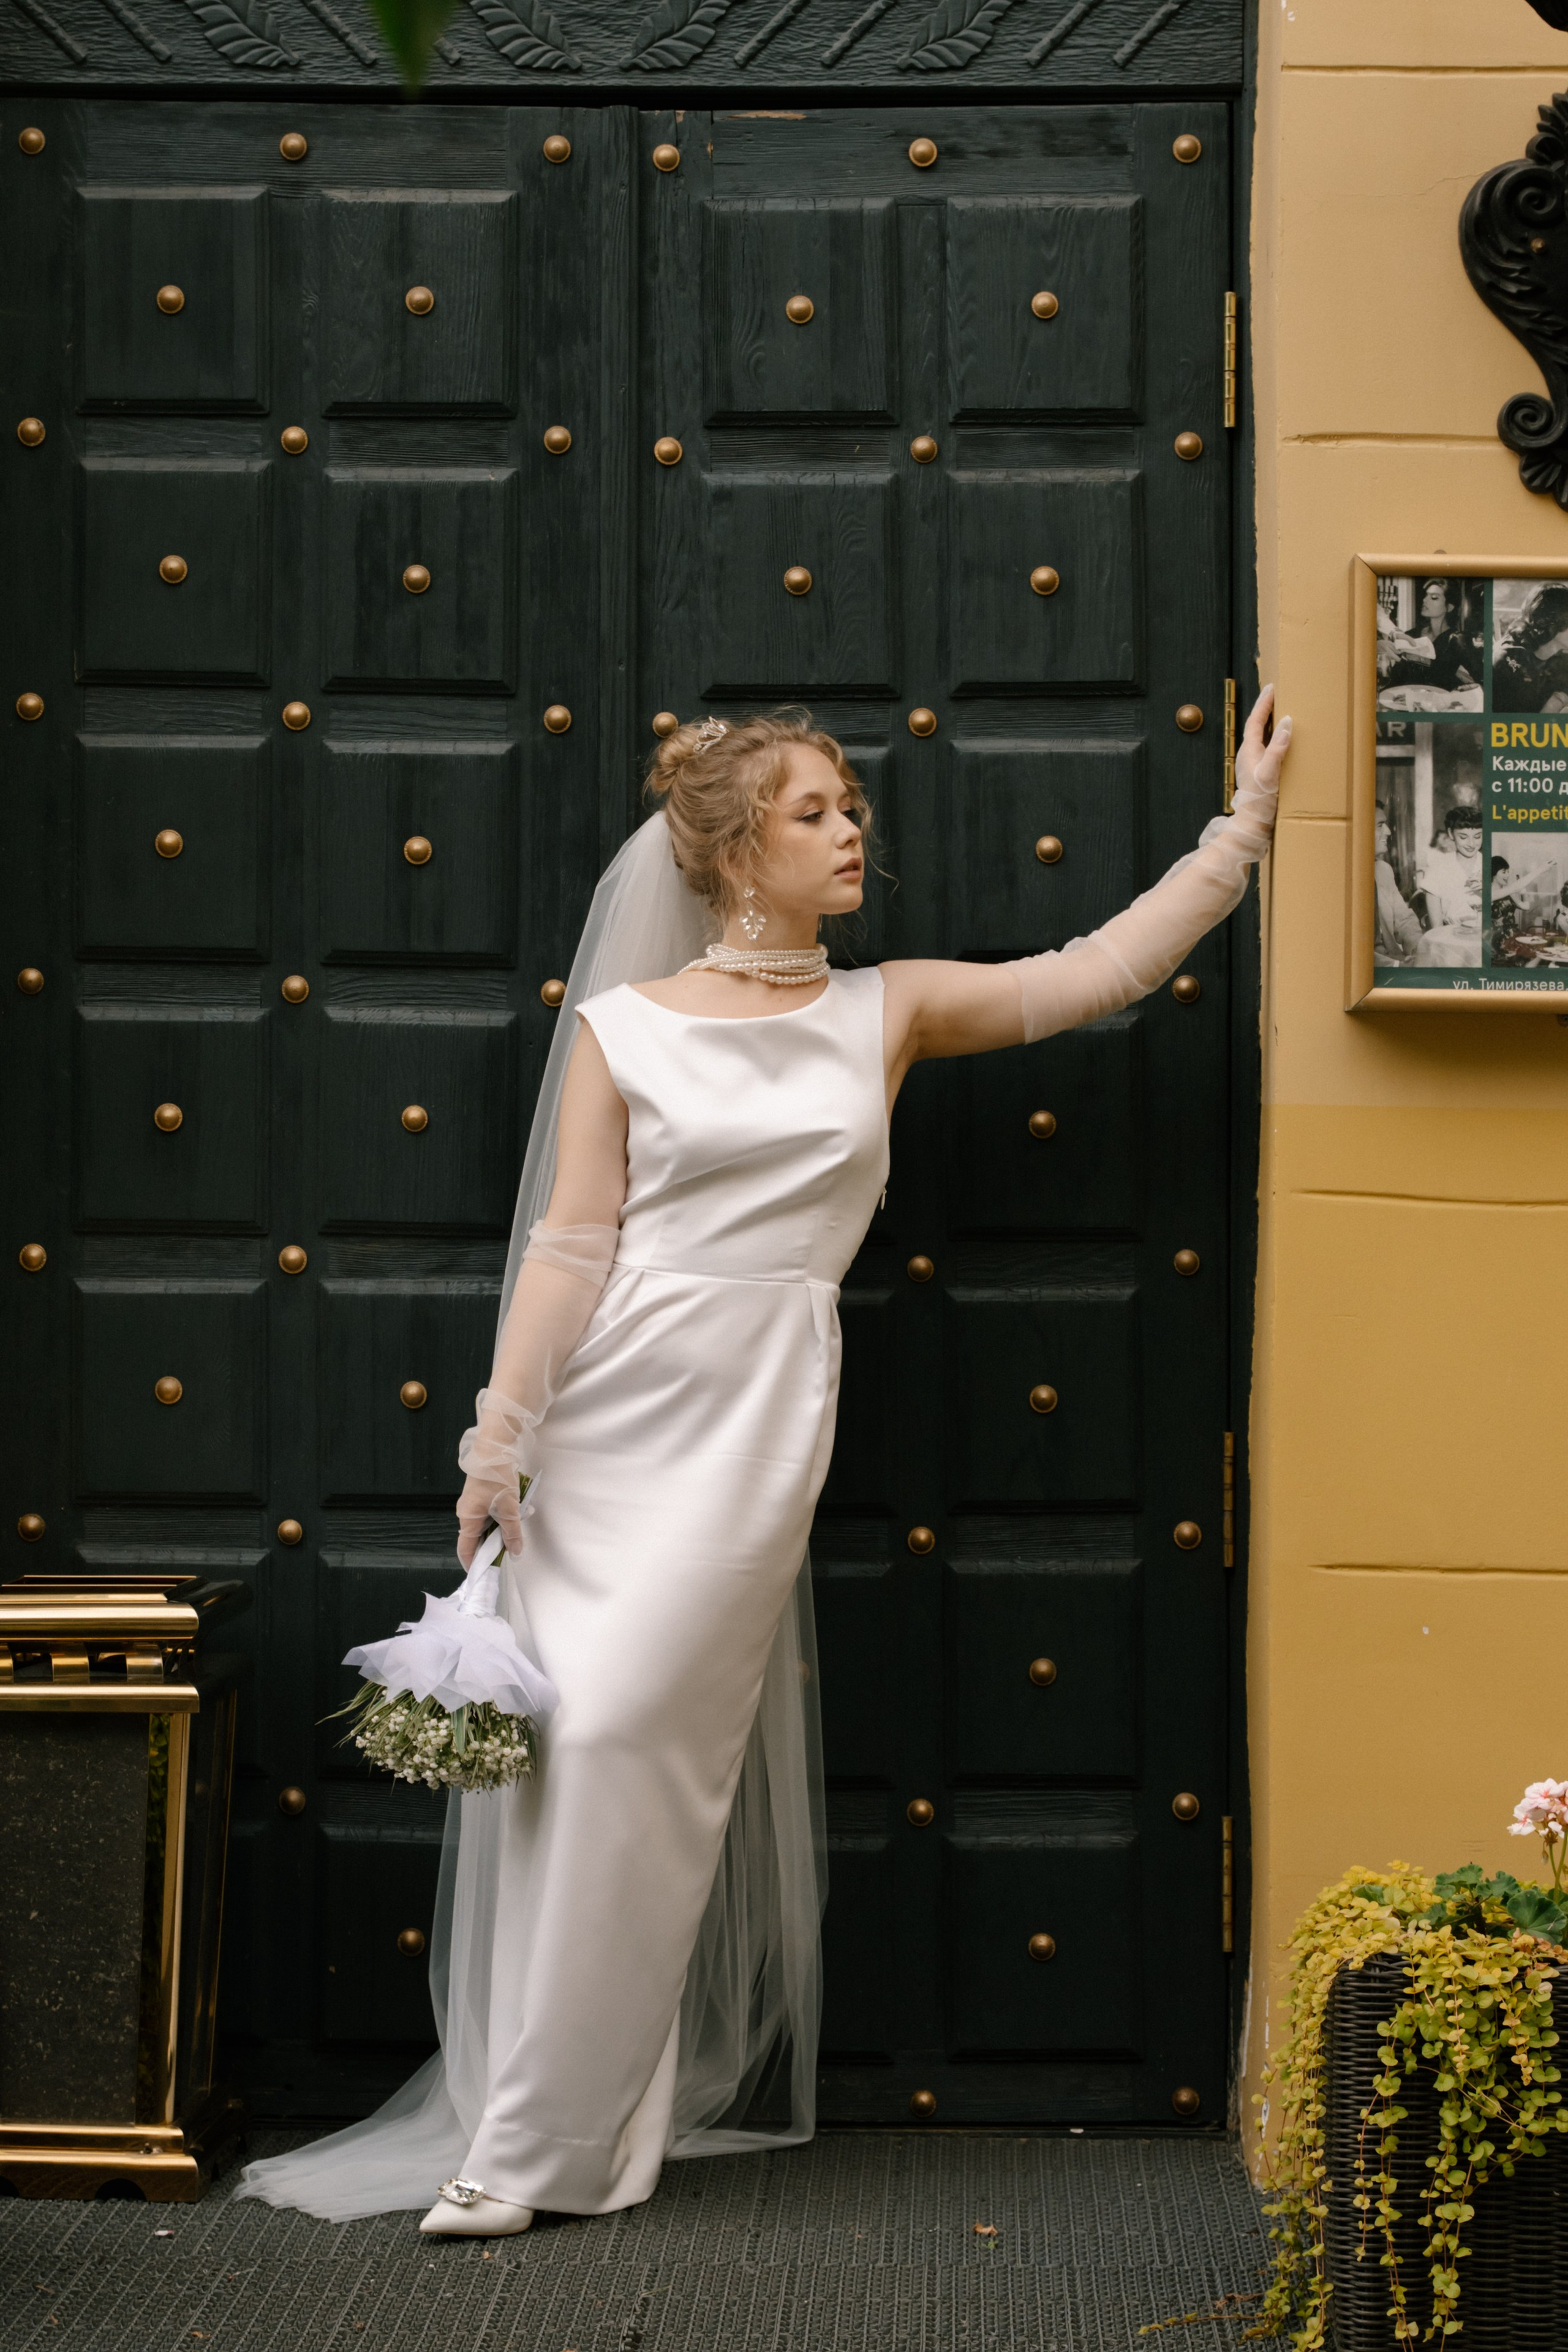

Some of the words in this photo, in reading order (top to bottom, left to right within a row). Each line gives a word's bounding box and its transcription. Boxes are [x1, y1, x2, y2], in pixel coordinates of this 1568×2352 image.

[1491, 723, 1568, 747] BRUN
[1493, 756, 1567, 772] Каждые
[1492, 781, 1502, 792] с
[1508, 778, 1553, 793] 11:00
[1492, 805, 1568, 823] L'appetit
[1453, 981, 1474, 990] ул.
